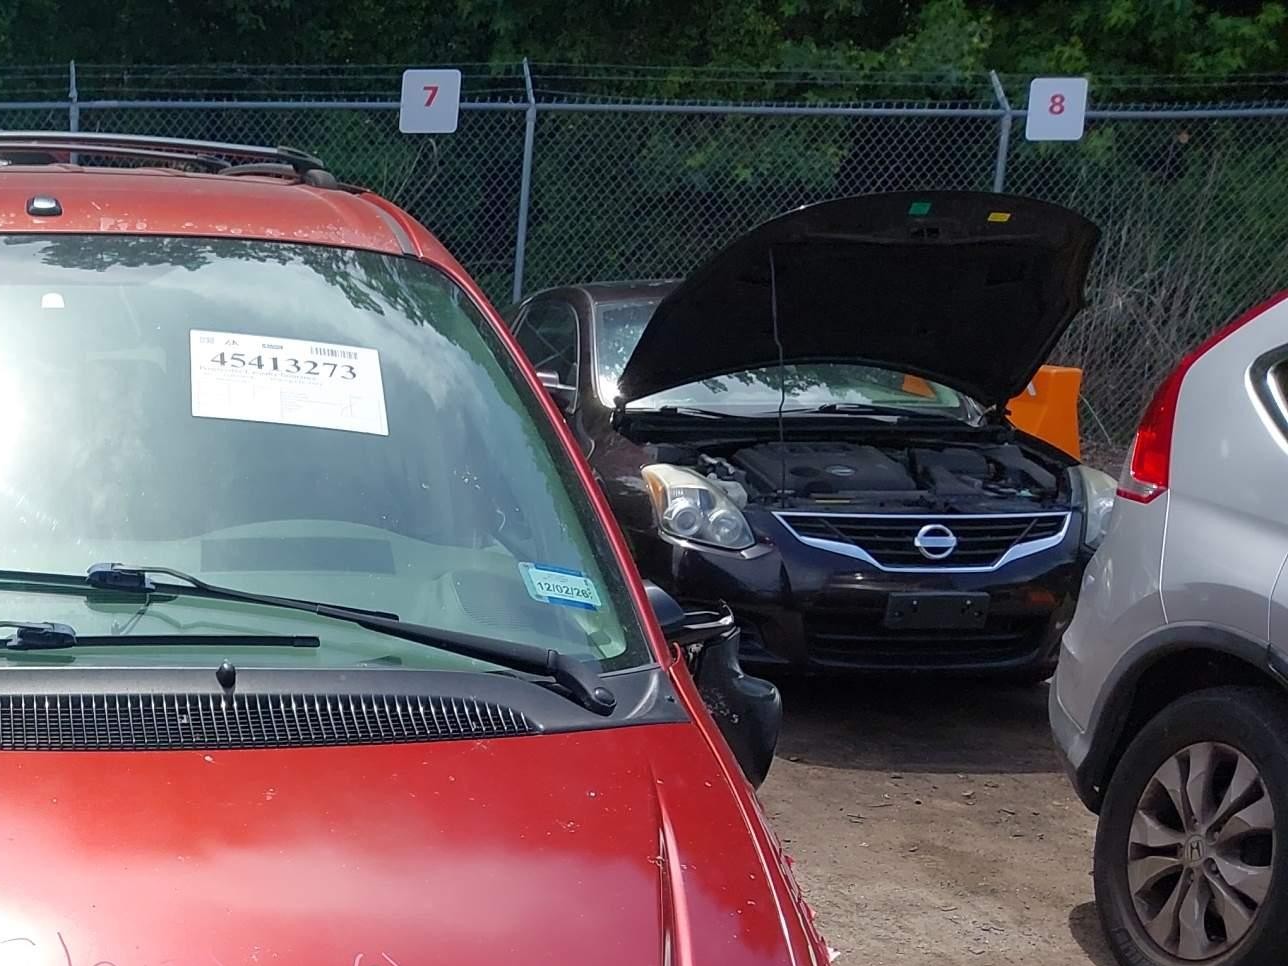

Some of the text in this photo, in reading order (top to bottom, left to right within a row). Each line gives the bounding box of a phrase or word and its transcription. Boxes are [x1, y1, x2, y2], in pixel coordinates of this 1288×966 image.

[423, 86, 439, 107] 7
[1049, 94, 1065, 115] 8
[210, 351, 357, 380] 45413273
